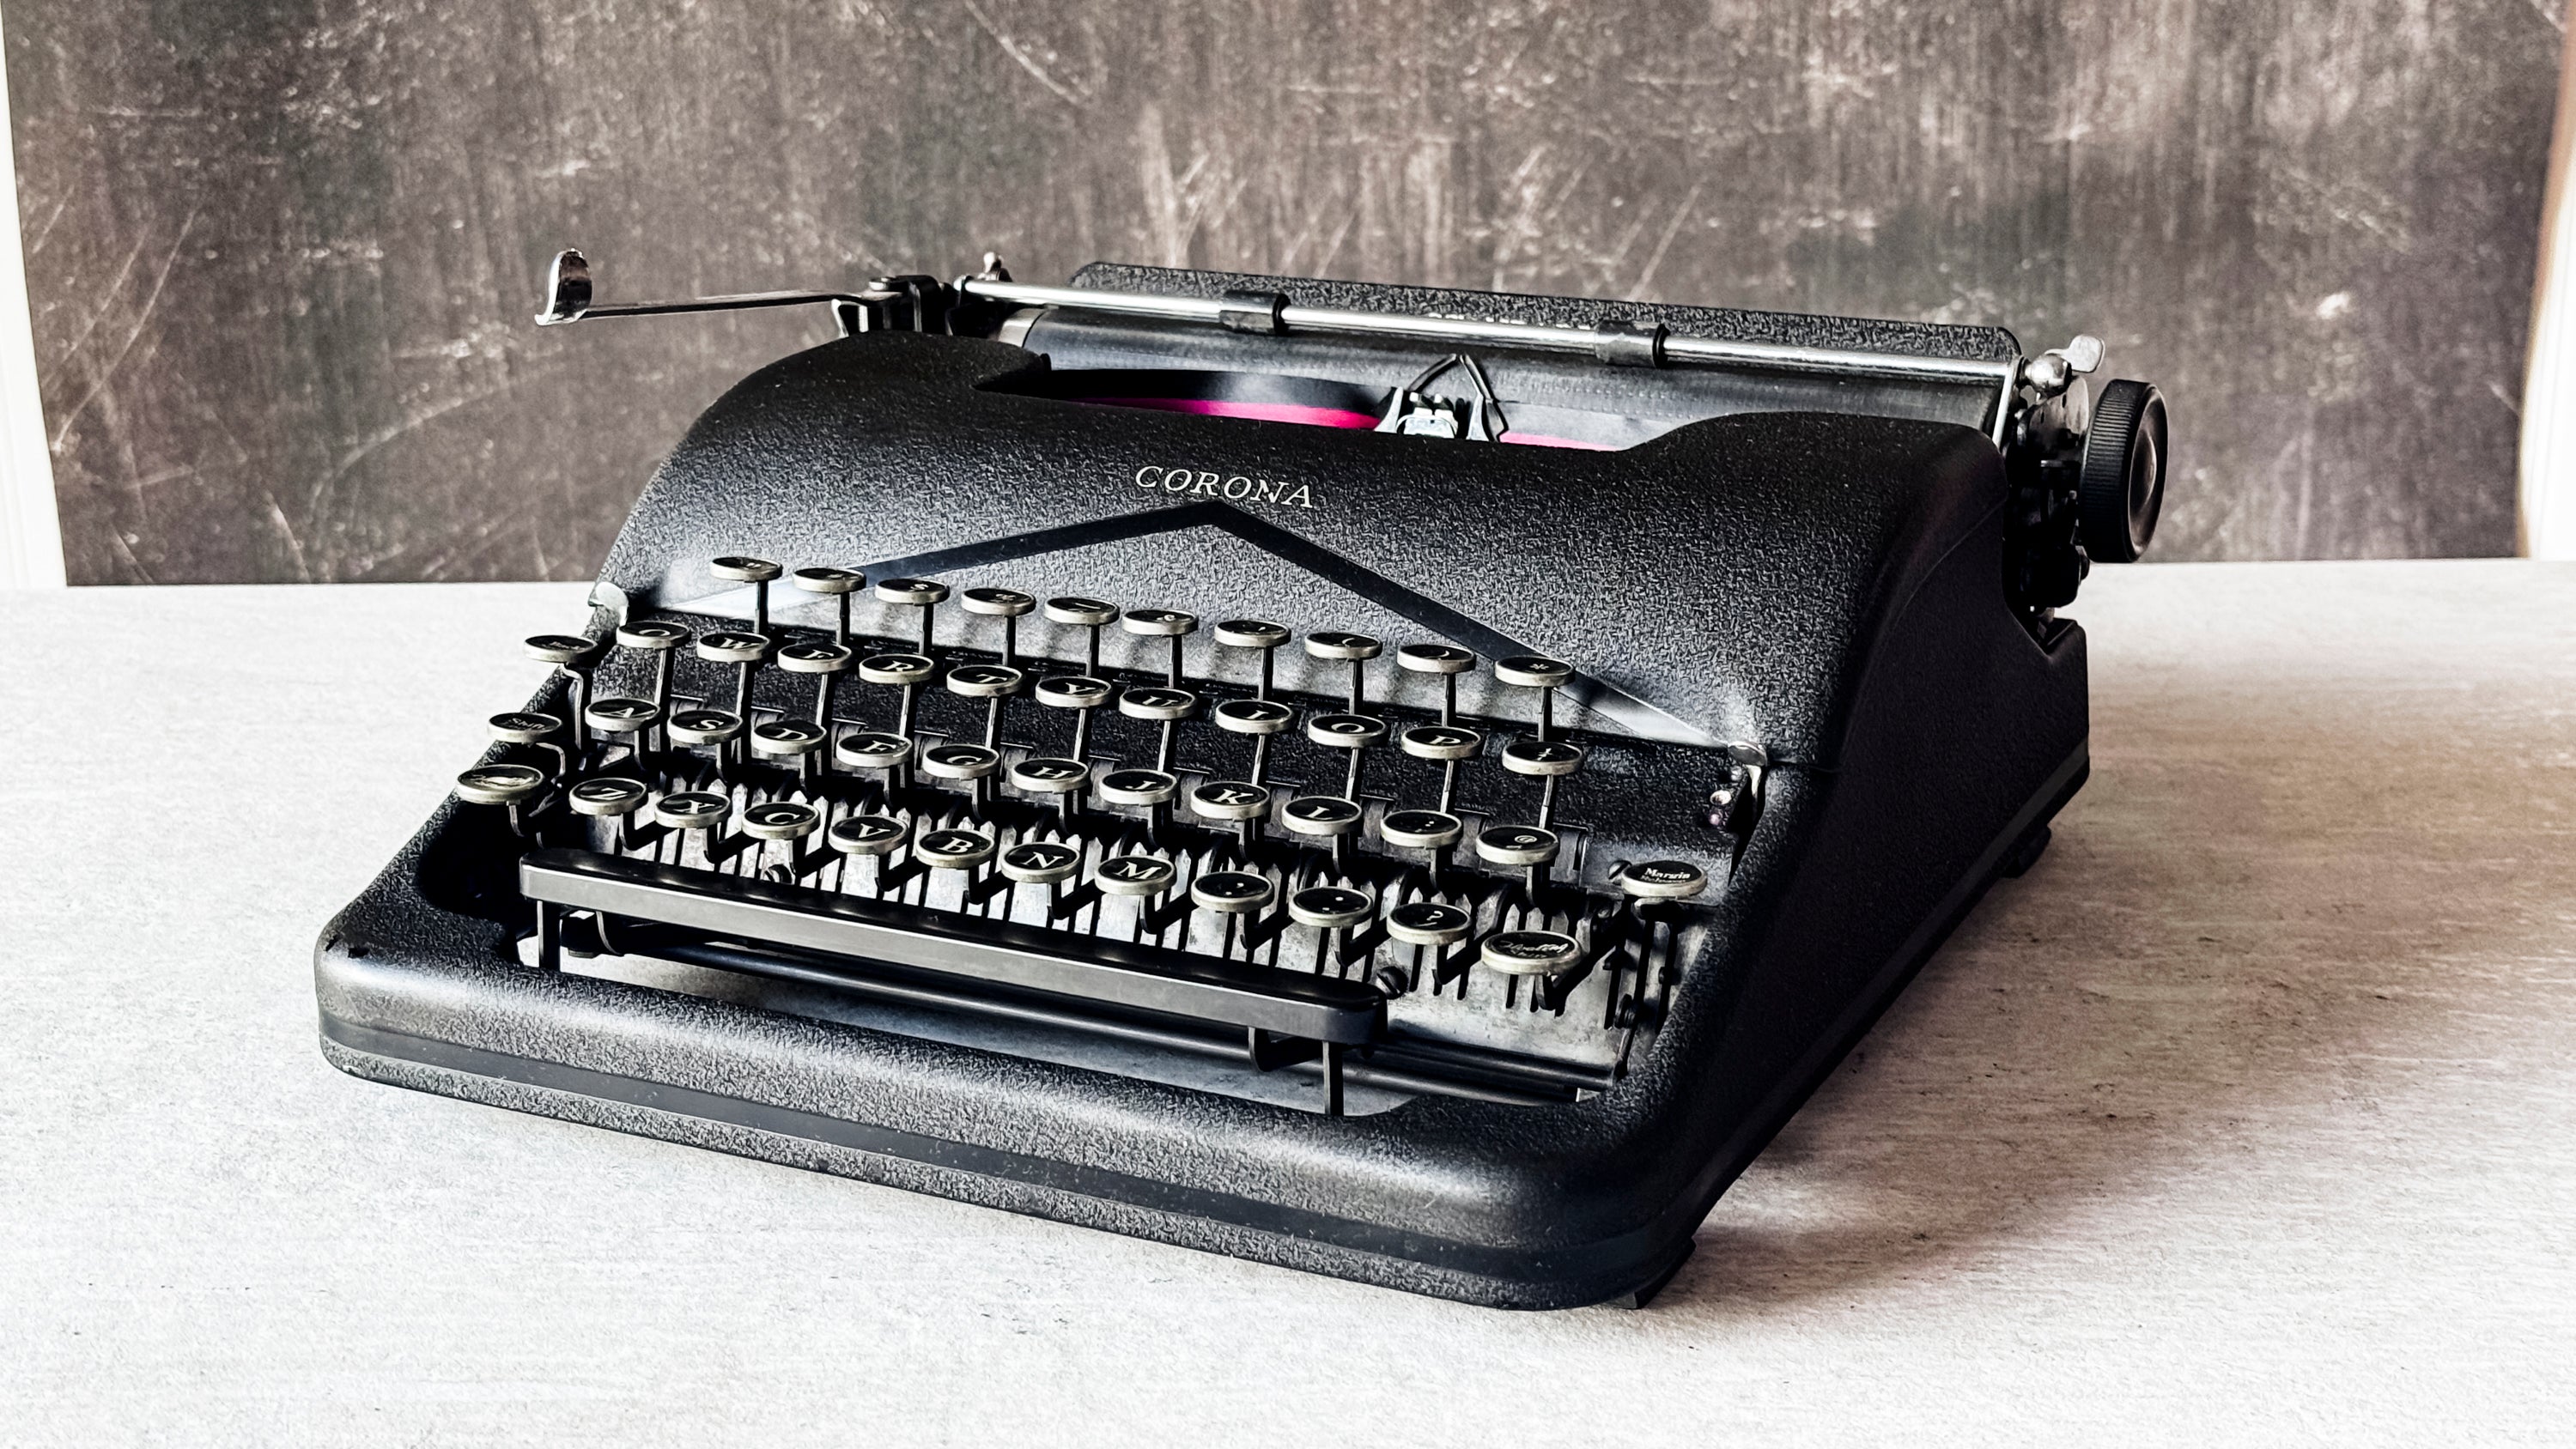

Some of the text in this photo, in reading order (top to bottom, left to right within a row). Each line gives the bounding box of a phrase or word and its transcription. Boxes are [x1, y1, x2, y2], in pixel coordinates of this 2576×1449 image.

[1134, 465, 1314, 508] CORONA
[593, 706, 635, 718] A
[690, 719, 724, 731] S
[776, 727, 808, 740] D
[1428, 734, 1461, 745] P
[860, 740, 896, 752] F
[1032, 766, 1074, 779] H
[1125, 780, 1157, 791] J
[1212, 788, 1254, 804] K
[765, 812, 800, 825] C
[858, 822, 891, 839] V
[937, 836, 974, 853] B
[1021, 851, 1065, 869] N
[1114, 861, 1163, 880] M
